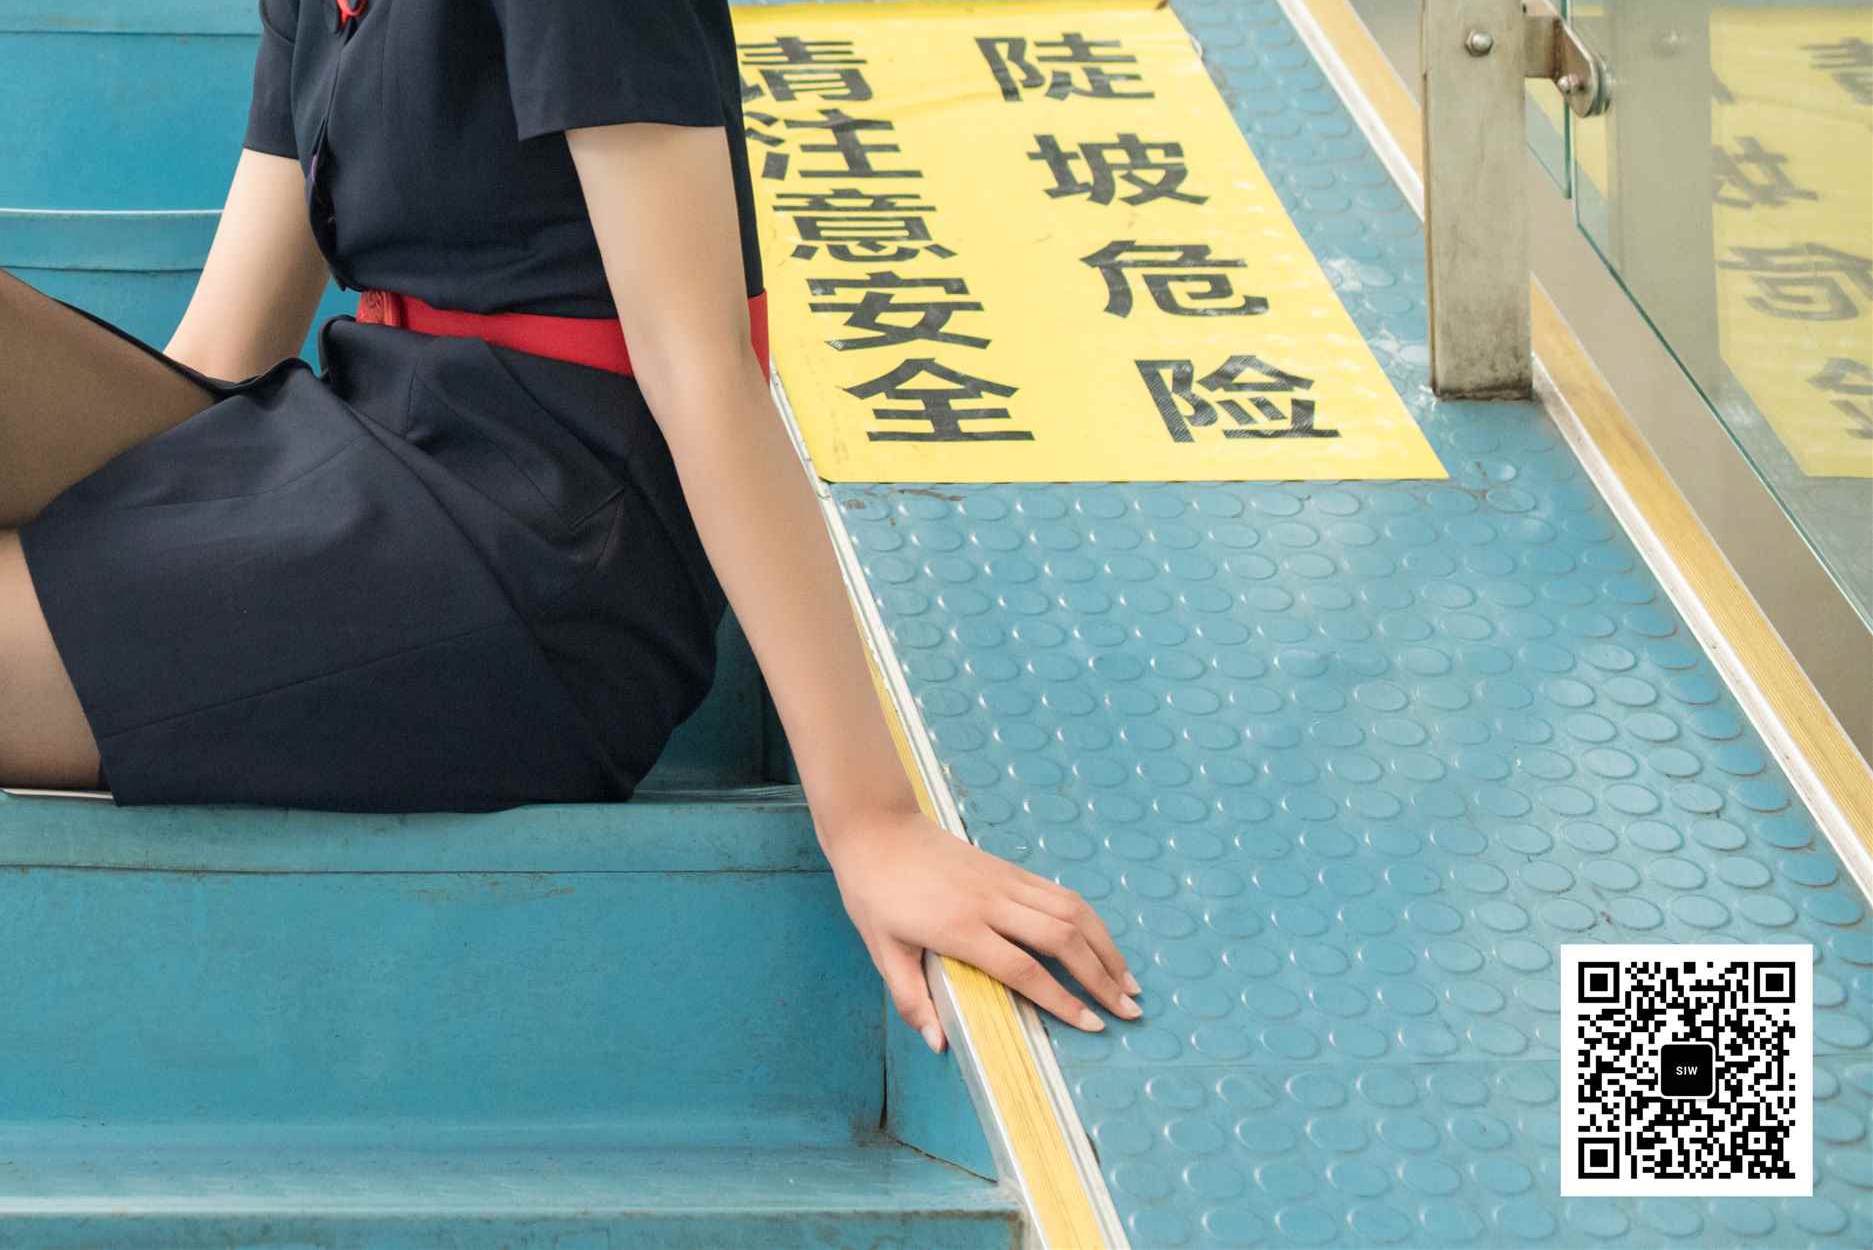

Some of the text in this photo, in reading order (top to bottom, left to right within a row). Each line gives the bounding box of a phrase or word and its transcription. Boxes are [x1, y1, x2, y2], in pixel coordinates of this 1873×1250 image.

[735, 36, 1036, 443] 请注意安全
[973, 31, 1342, 444] 陡坡危险
